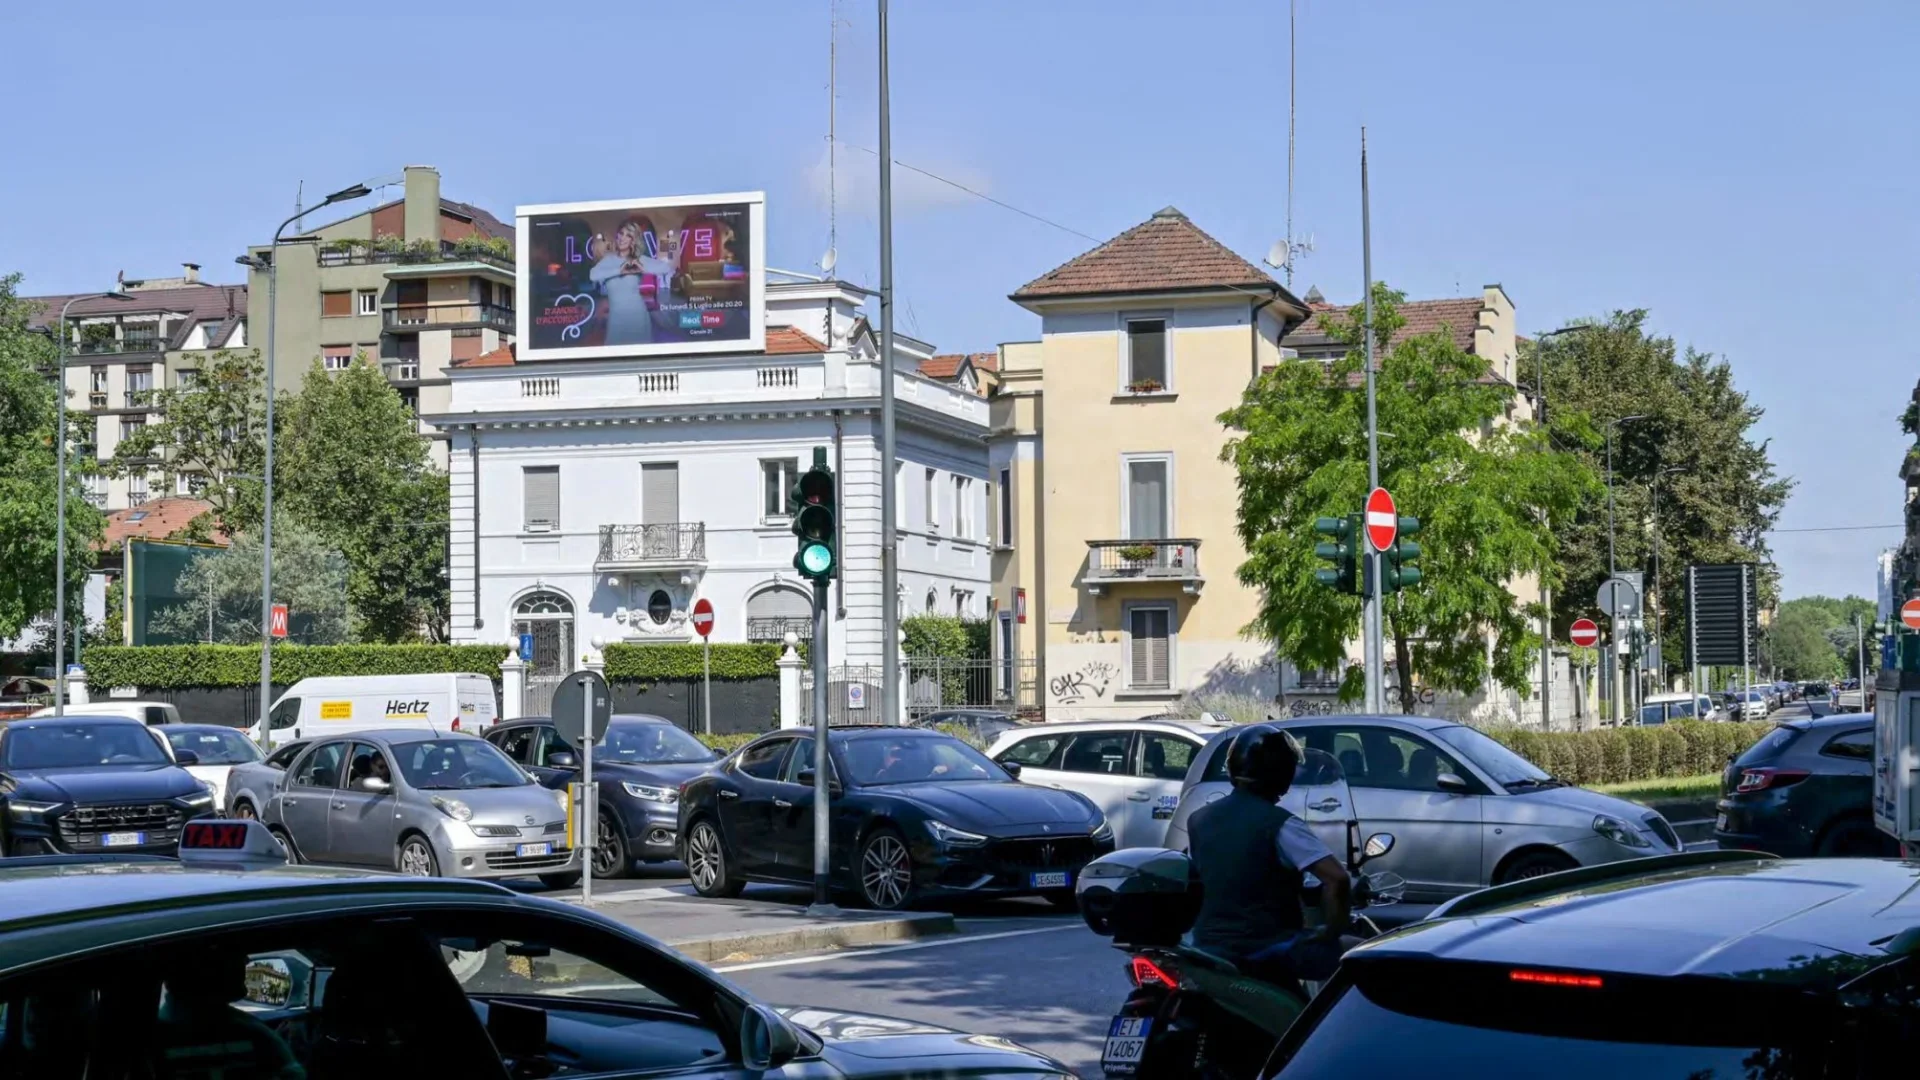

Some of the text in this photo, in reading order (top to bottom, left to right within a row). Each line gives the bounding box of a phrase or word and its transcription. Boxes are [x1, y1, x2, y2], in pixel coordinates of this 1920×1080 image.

[694, 302, 712, 310] Luglio
[682, 315, 720, 324] Real Time
[272, 611, 286, 631] M
[386, 700, 429, 714] Hertz
[460, 701, 475, 712] Hertz
[186, 824, 245, 847] TAXI
[1119, 1018, 1138, 1036] ET
[1108, 1040, 1144, 1058] 14067
